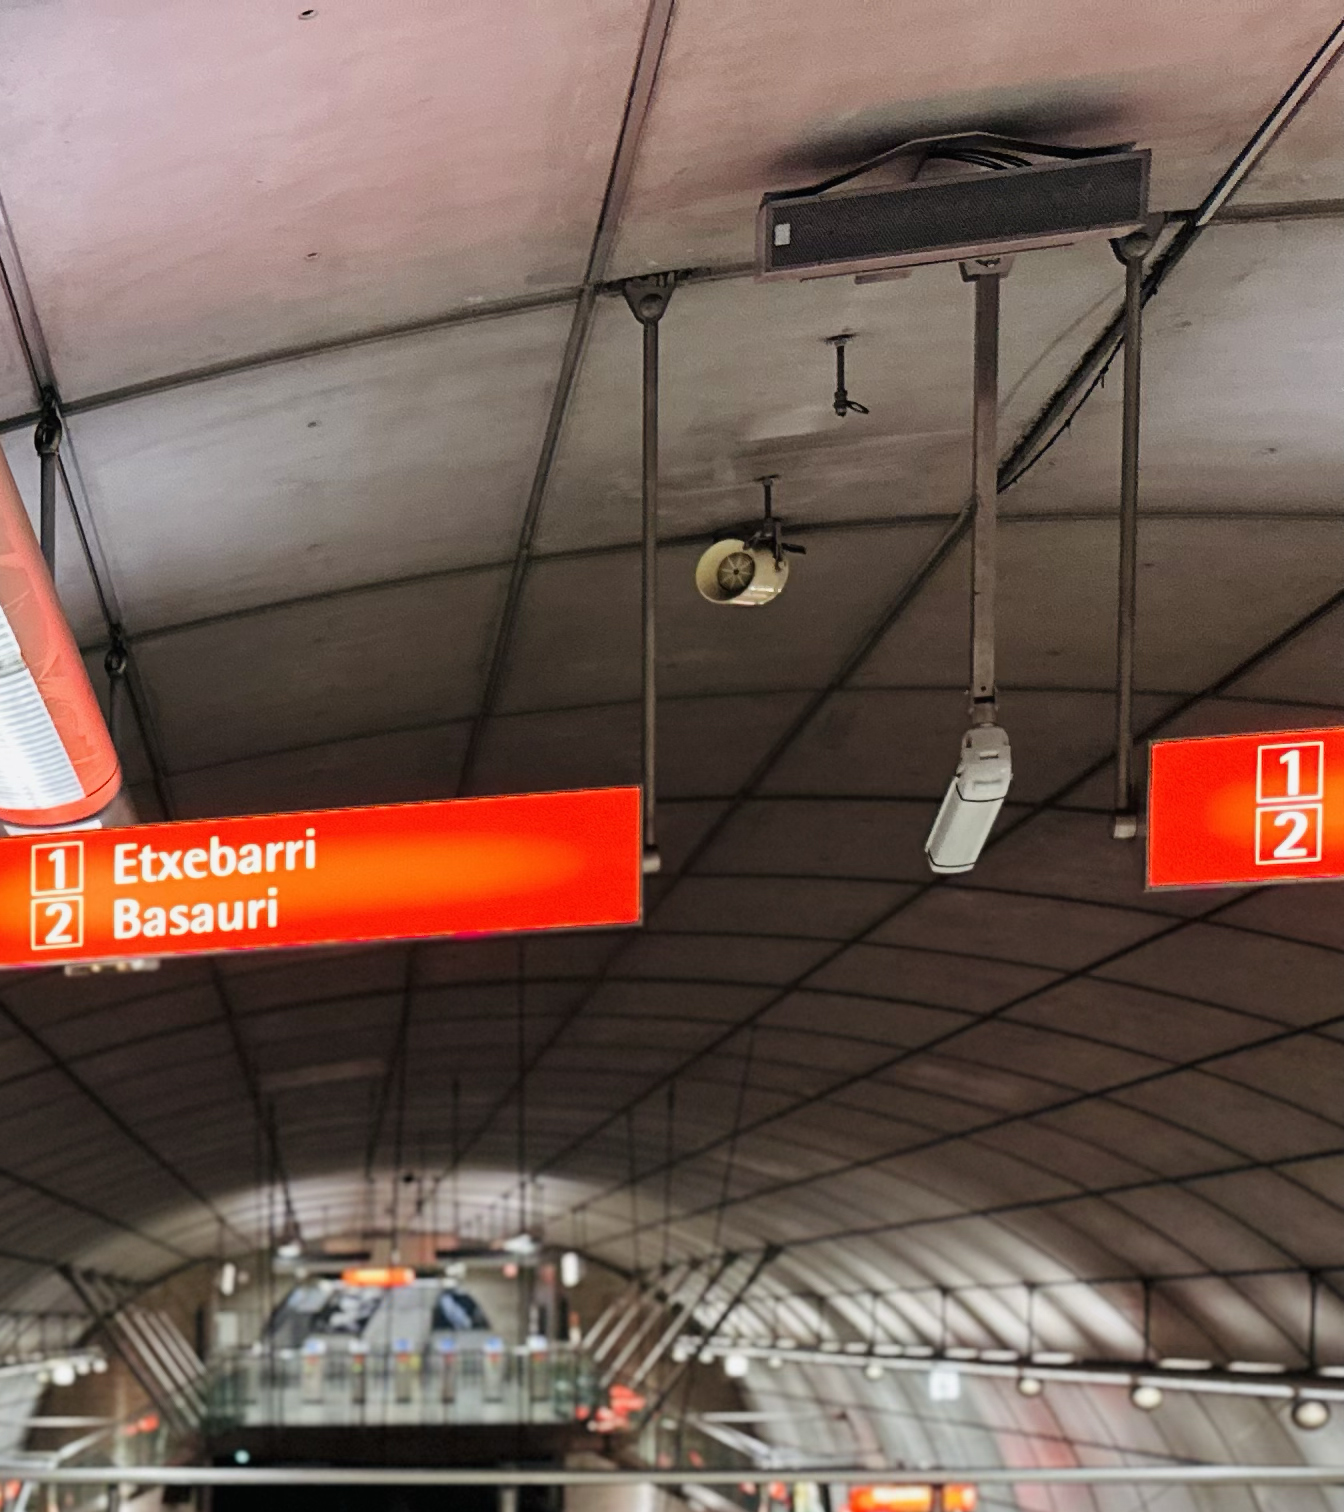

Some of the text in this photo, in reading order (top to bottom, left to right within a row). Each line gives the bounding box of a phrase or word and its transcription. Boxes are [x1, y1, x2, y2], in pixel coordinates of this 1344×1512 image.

[1279, 750, 1301, 796] 1
[49, 829, 318, 890] 1 Etxebarri
[1273, 811, 1309, 858] 2
[46, 888, 278, 945] 2 Basauri
